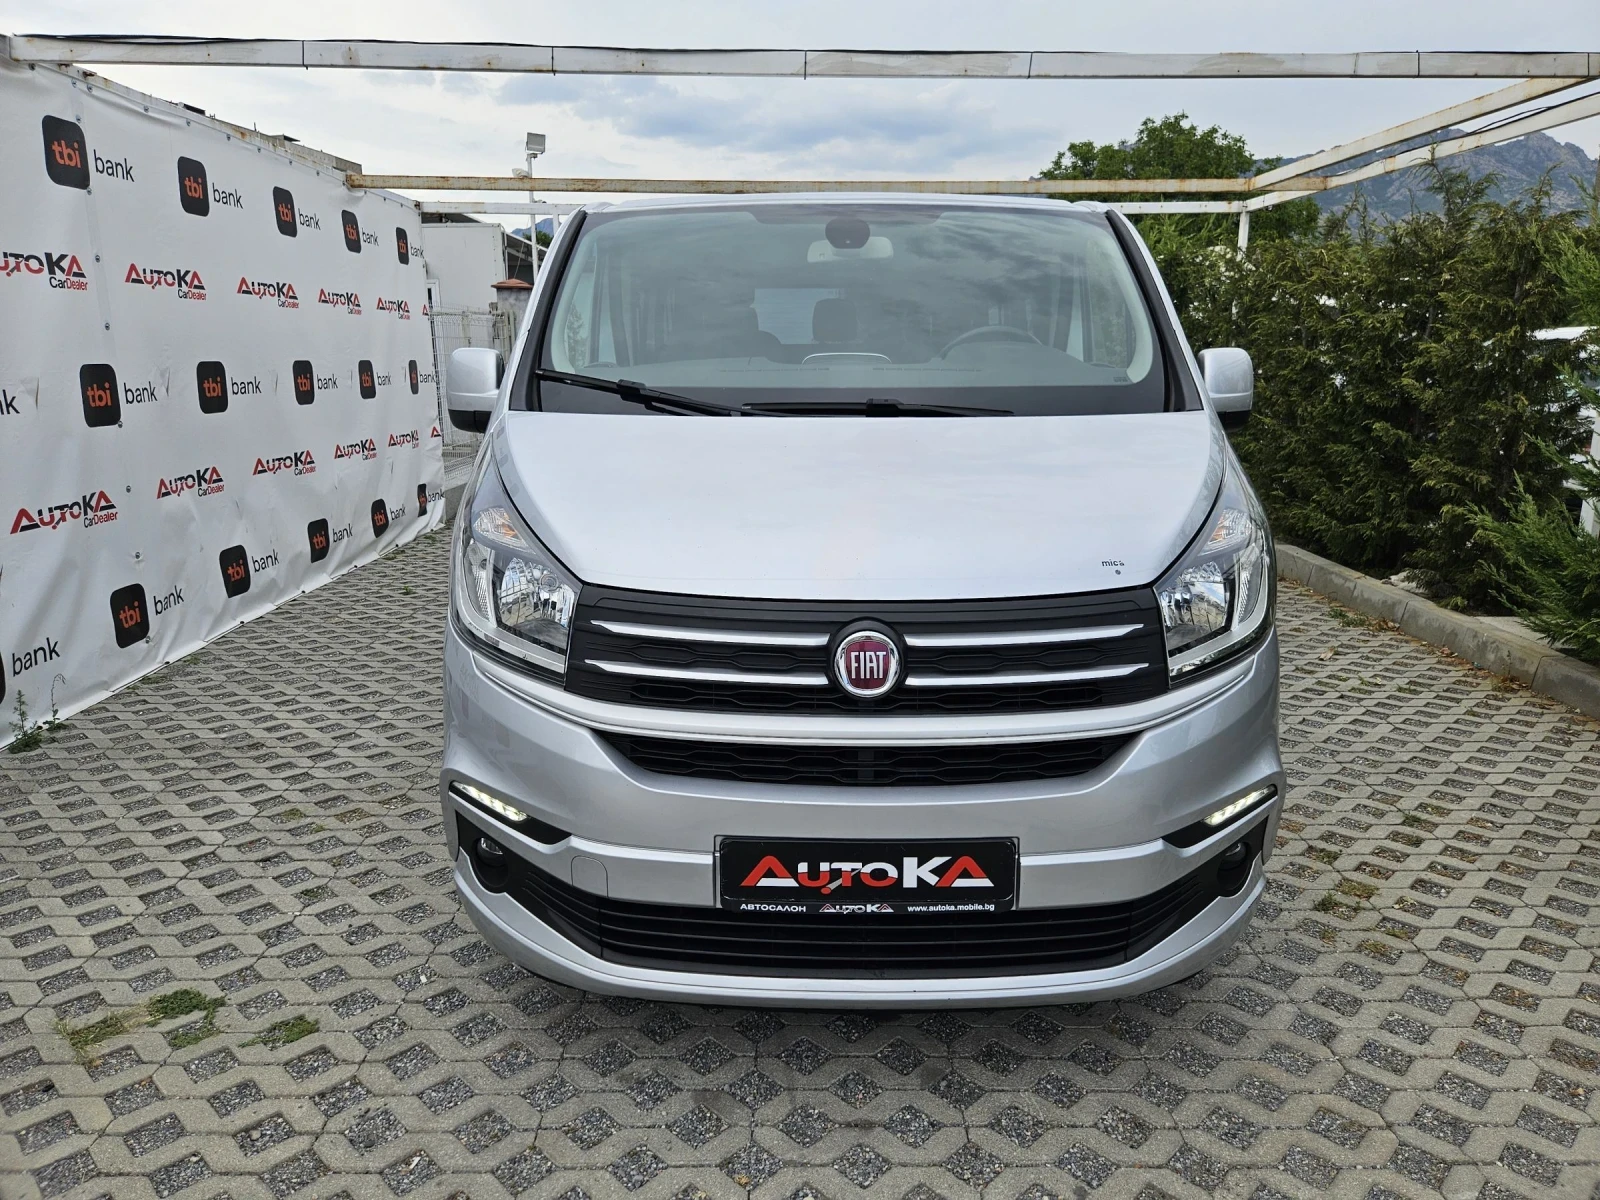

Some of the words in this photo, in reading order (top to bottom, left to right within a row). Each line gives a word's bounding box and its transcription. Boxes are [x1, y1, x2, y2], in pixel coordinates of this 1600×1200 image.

[52, 140, 81, 168] tbi
[93, 149, 135, 182] bank
[184, 177, 203, 198] tbi
[212, 182, 244, 209] bank
[278, 204, 292, 222] tbi
[298, 208, 321, 231] bank
[361, 228, 379, 247] bank
[203, 376, 222, 397] tbi
[231, 376, 262, 396] bank
[297, 374, 311, 391] tbi
[317, 374, 338, 391] bank
[376, 372, 391, 386] bank
[419, 372, 436, 384] bank
[87, 382, 112, 408] tbi
[124, 381, 158, 404] bank
[428, 489, 445, 502] bank
[390, 504, 406, 520] bank
[313, 531, 326, 550] tbi
[332, 523, 353, 543] bank
[227, 559, 245, 582] tbi
[251, 548, 279, 573] bank
[119, 601, 141, 628] tbi
[153, 585, 185, 615] bank
[12, 637, 61, 677] bank
[850, 651, 887, 679] FIAT
[740, 903, 807, 913] АВТОСАЛОН
[907, 903, 995, 912] www.autoka.mobile.bg
